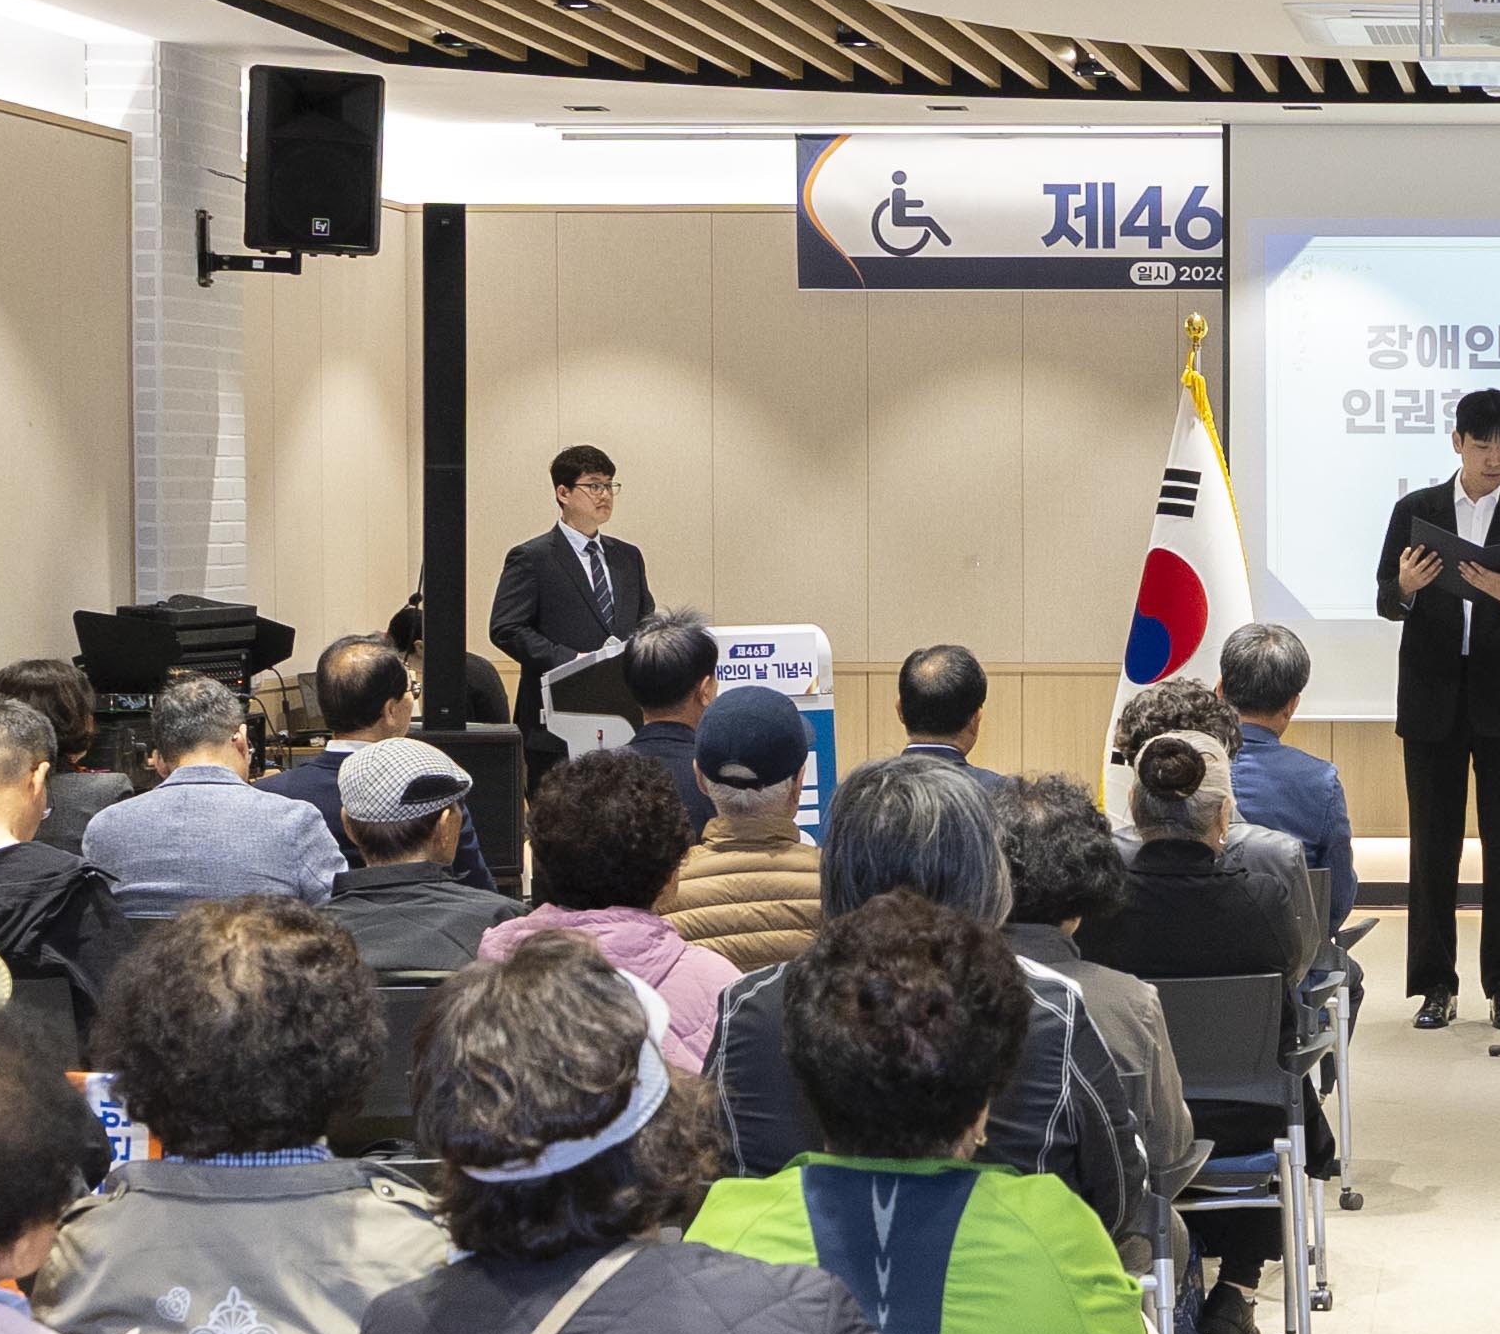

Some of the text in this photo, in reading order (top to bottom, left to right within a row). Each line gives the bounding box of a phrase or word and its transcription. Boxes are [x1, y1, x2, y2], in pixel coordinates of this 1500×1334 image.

[1041, 182, 1223, 251] 제46
[1137, 265, 1168, 281] 일시
[735, 645, 770, 657] 제46회
[755, 663, 768, 680] 날
[772, 661, 813, 679] 기념식
